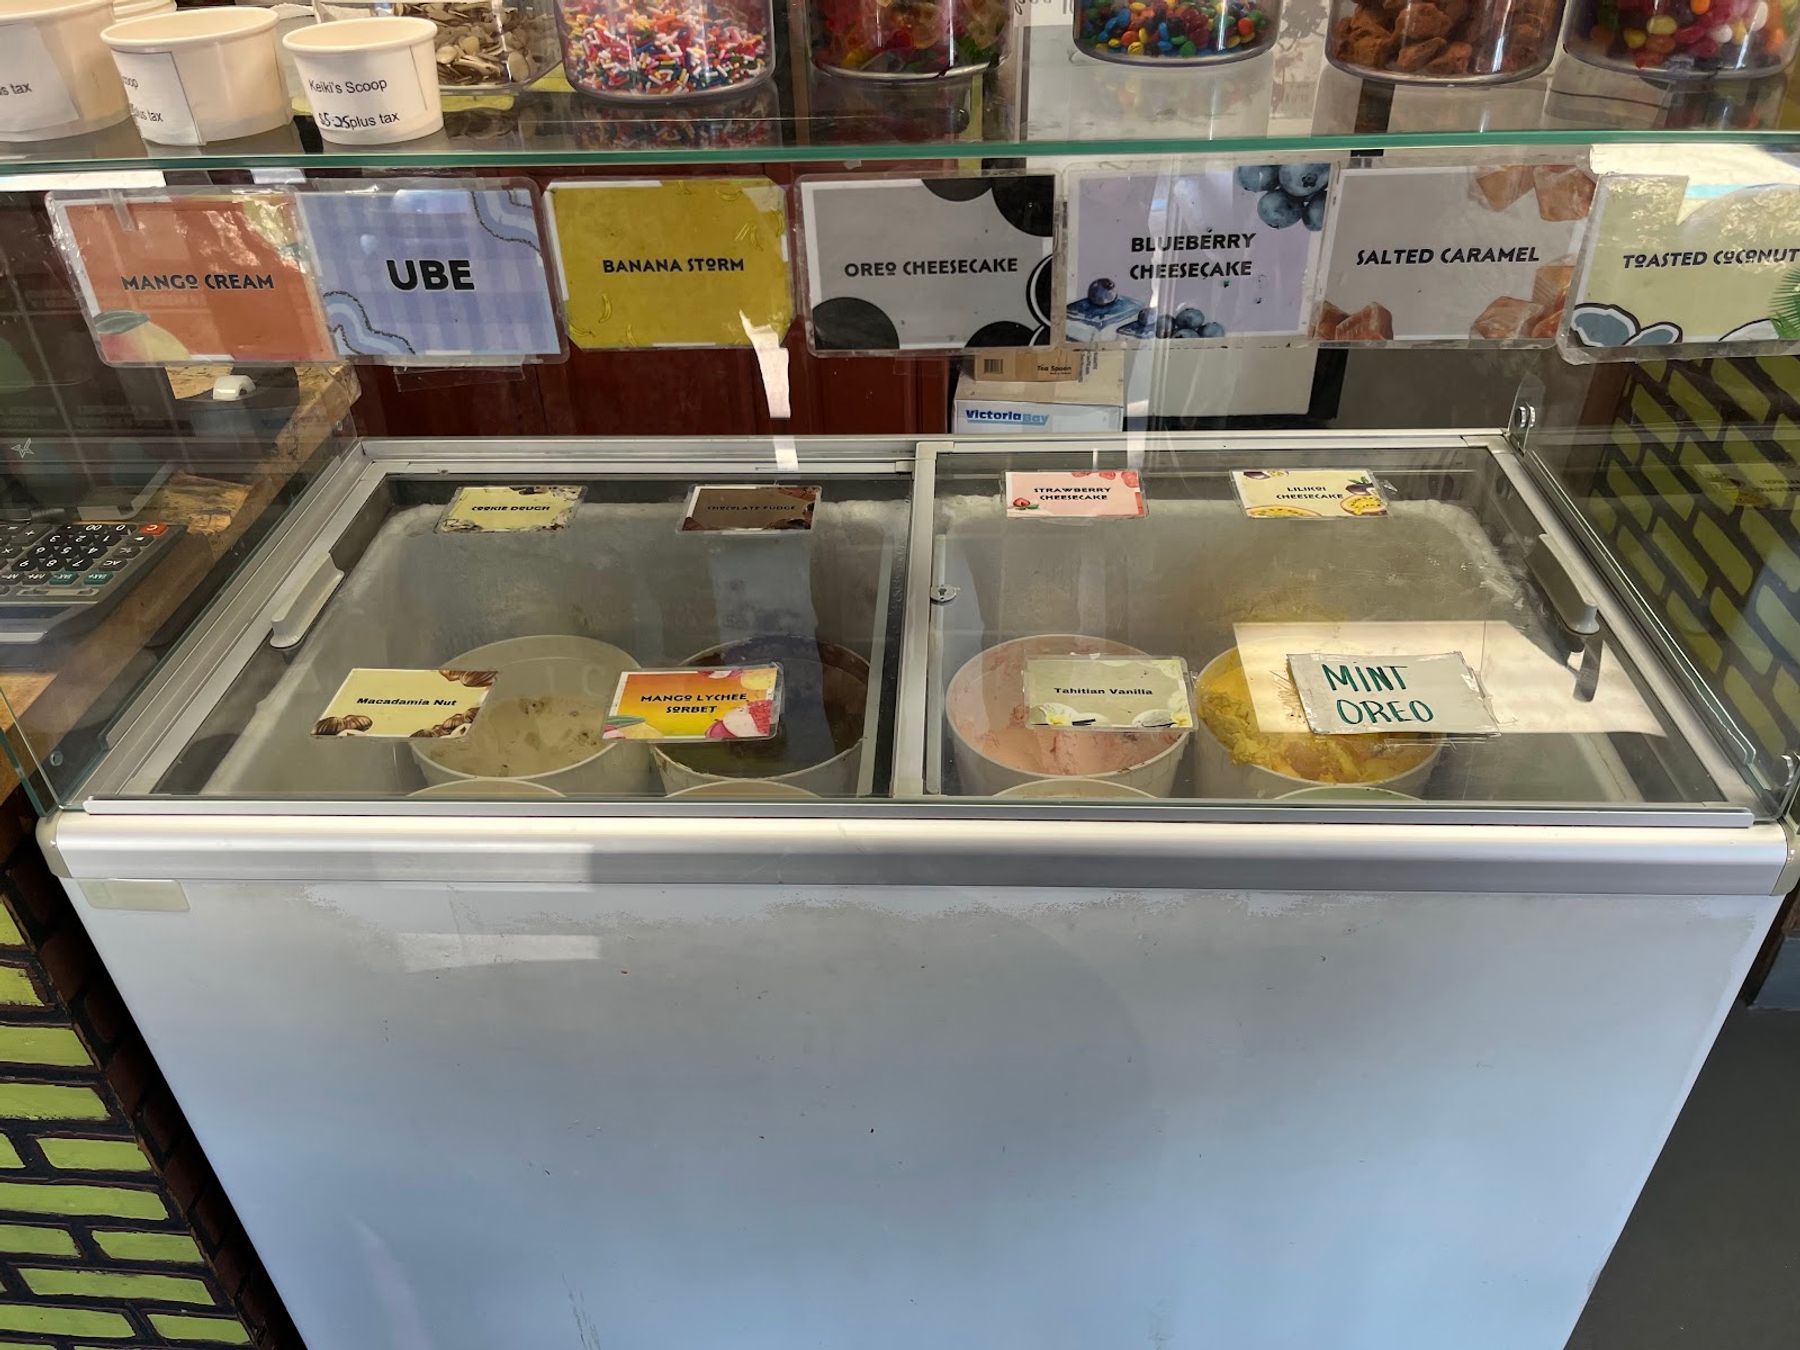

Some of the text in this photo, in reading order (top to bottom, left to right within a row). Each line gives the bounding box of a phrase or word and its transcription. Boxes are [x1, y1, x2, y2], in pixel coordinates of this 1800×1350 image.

[10, 82, 33, 94] tax
[308, 79, 388, 94] Keiki's Scoop
[147, 109, 164, 122] tax
[379, 112, 401, 124] tax
[1131, 233, 1257, 252] BLUEBERRY
[1356, 246, 1540, 266] SALTED CARAMEL
[1622, 248, 1800, 269] TOASTED COCONUT
[602, 257, 745, 274] BANANA STORM
[844, 257, 1019, 278] OREO CHEESECAKE
[1129, 260, 1254, 280] CHEESECAKE
[120, 273, 275, 291] MANGO CREAM
[386, 259, 476, 291] UBE
[46, 559, 58, 567] 8
[640, 692, 748, 703] MANGO LYCHEE
[1053, 687, 1153, 696] Tahitian Vanilla
[356, 697, 430, 706] Macadamia
[665, 705, 719, 714] SORBET
[1336, 699, 1435, 725] OREO
